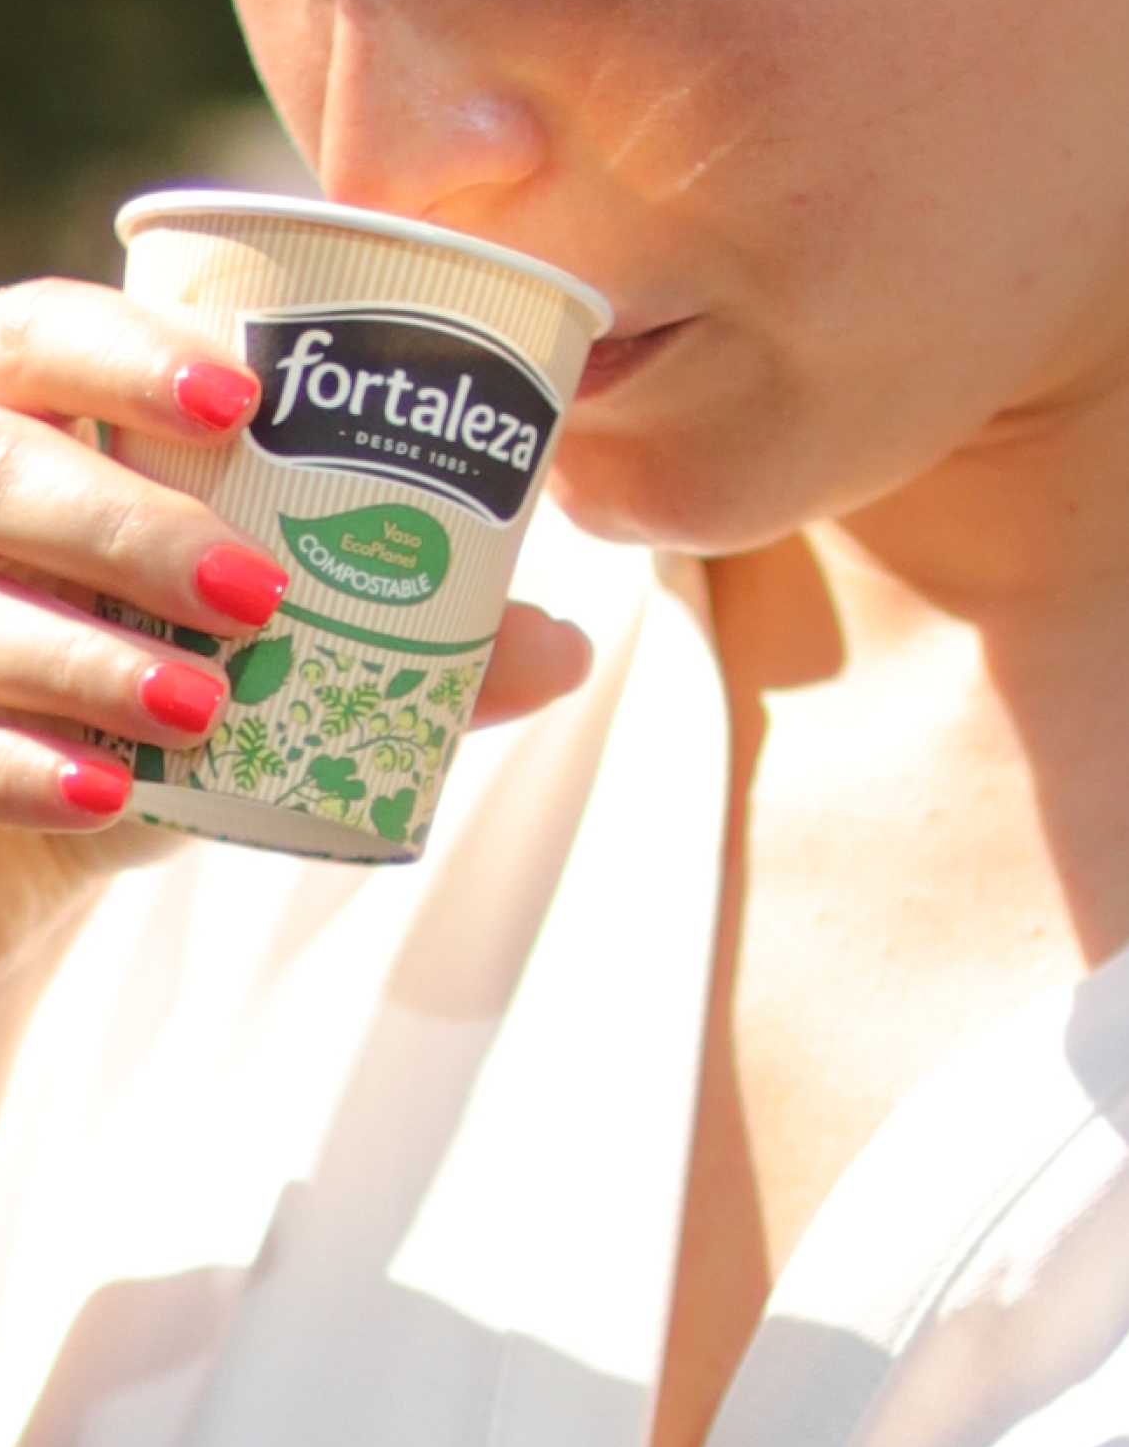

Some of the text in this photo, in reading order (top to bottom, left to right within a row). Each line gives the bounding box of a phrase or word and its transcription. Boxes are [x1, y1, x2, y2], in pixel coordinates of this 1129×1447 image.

[271, 329, 538, 472] fortaleza
[355, 430, 423, 460] DESDE
[384, 520, 423, 549] Vaso
[298, 533, 432, 599] COMPOSTABLE
